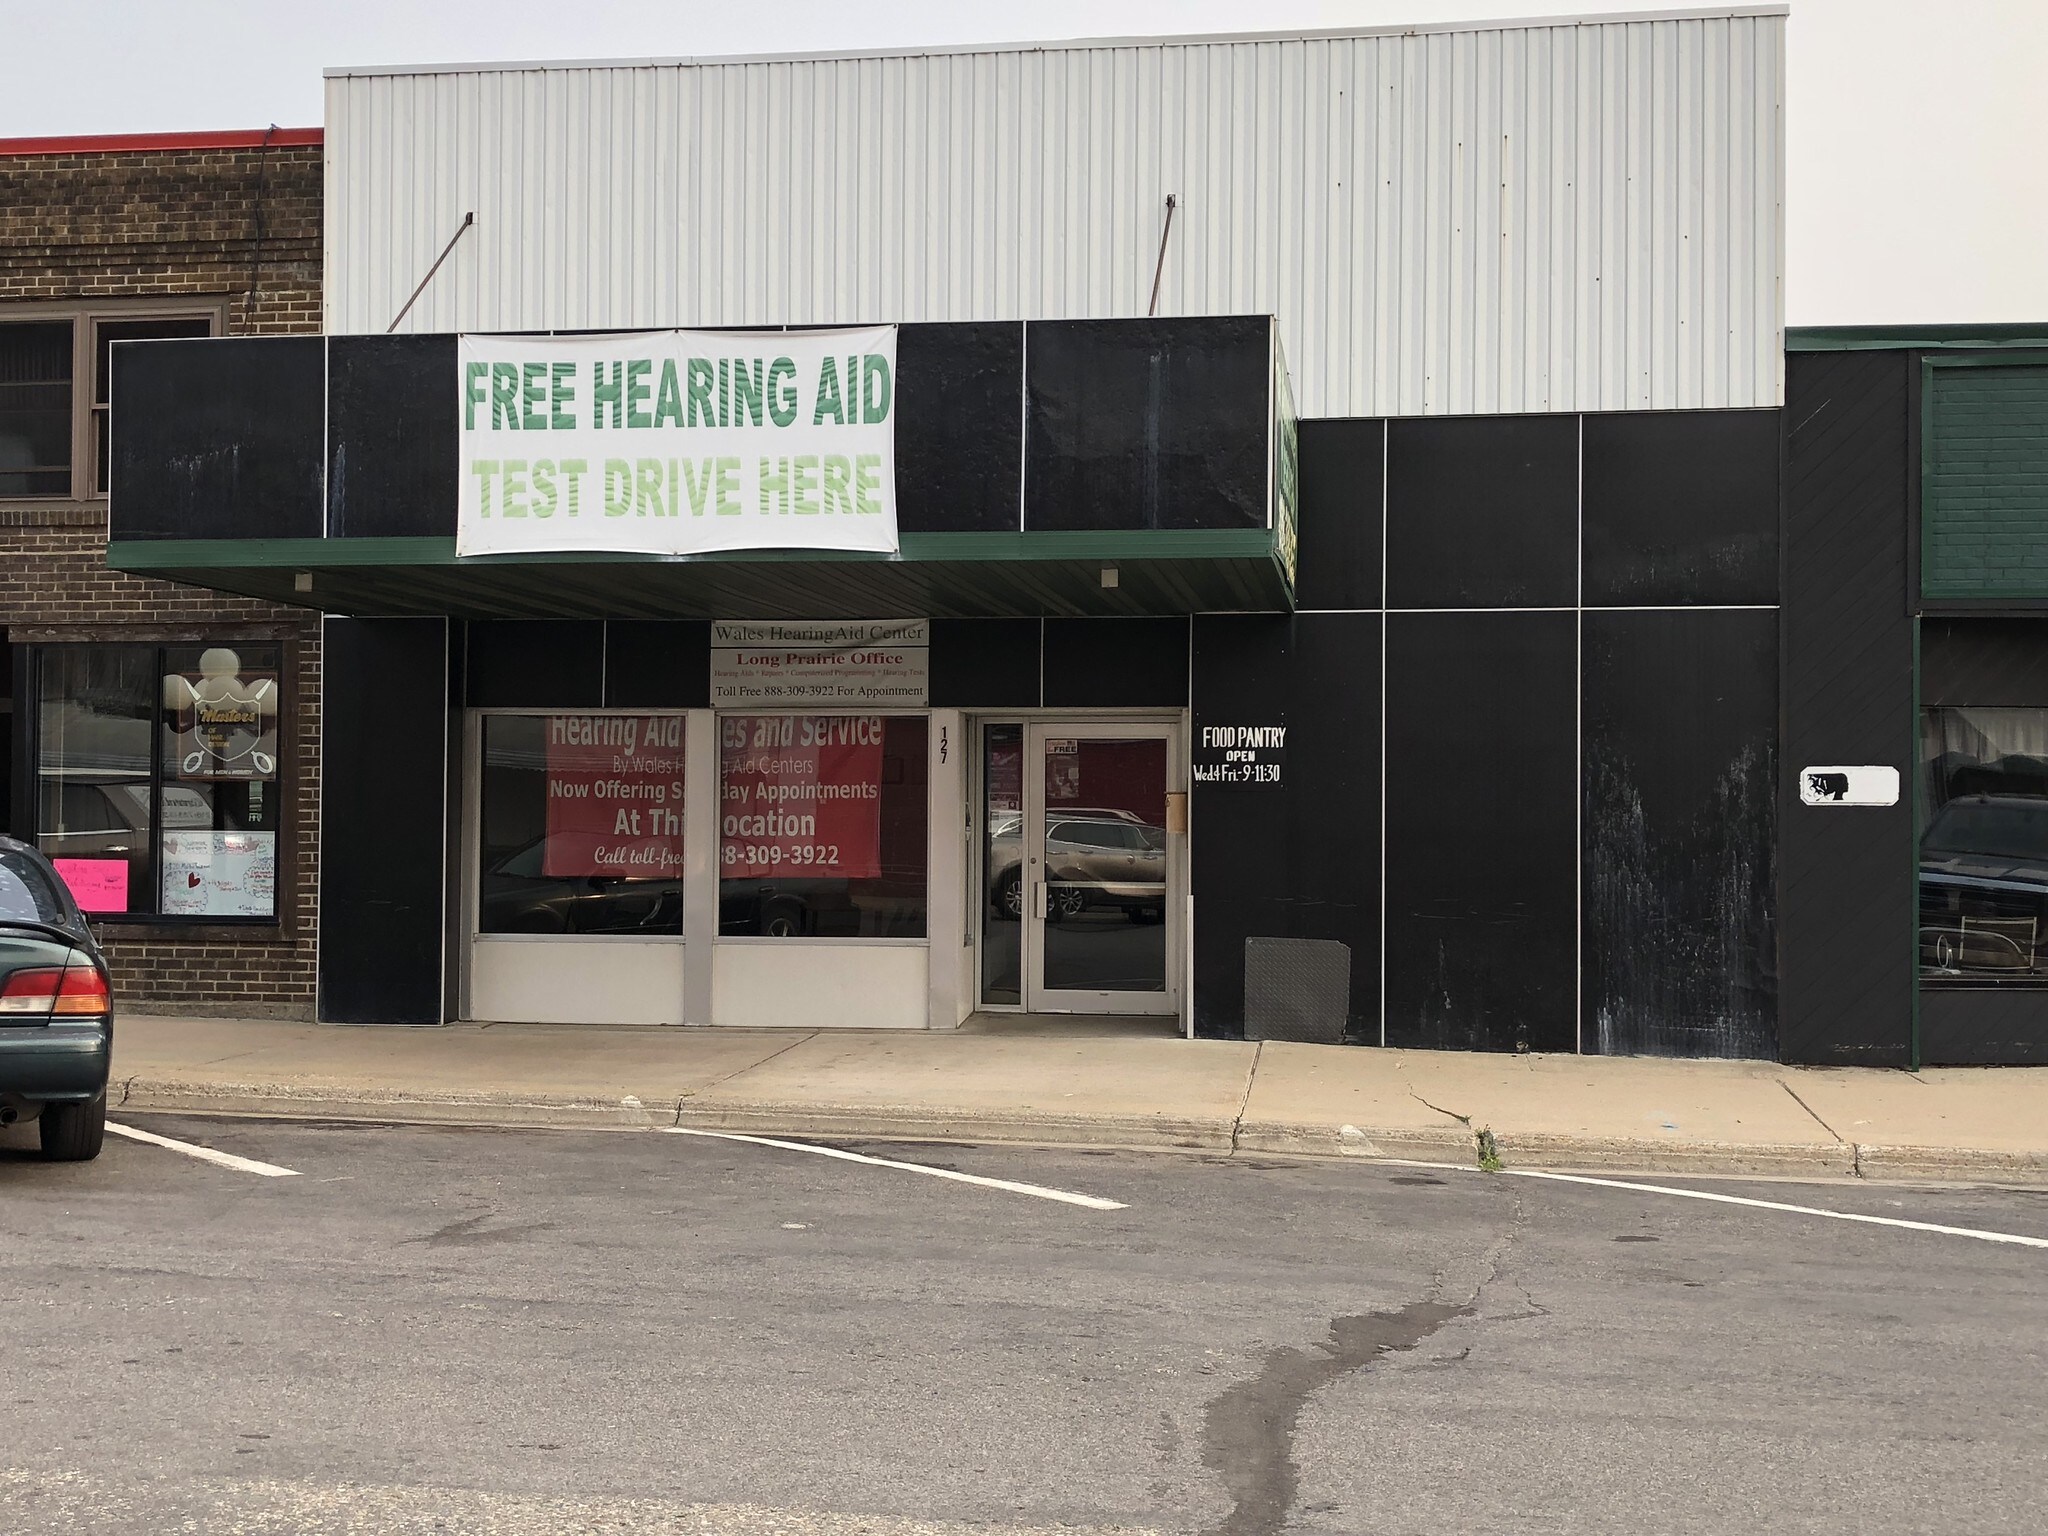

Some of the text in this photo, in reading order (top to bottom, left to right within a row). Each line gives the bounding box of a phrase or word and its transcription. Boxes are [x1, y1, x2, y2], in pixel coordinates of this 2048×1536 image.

[465, 353, 891, 431] FREE HEARING AID
[472, 454, 882, 519] TEST DRIVE HERE
[715, 626, 764, 641] Wales
[870, 626, 924, 640] Center
[737, 652, 903, 668] Long Prairie Office
[715, 685, 924, 699] Toll Free 888-309-3922 For Appointment
[552, 716, 638, 756] Hearing
[643, 716, 682, 747] Aid
[753, 716, 795, 748] and
[800, 716, 883, 747] Service
[940, 725, 948, 765] 127
[1202, 726, 1287, 749] FOOD PANTRY
[613, 755, 629, 777] By
[632, 755, 672, 775] Wales
[732, 756, 756, 775] Aid
[759, 756, 813, 775] Centers
[1225, 750, 1256, 762] OPEN
[550, 779, 589, 798] Now
[594, 779, 665, 803] Offering
[756, 780, 878, 804] Appointments
[614, 808, 816, 837] At Thi ocation
[594, 846, 627, 865] Call
